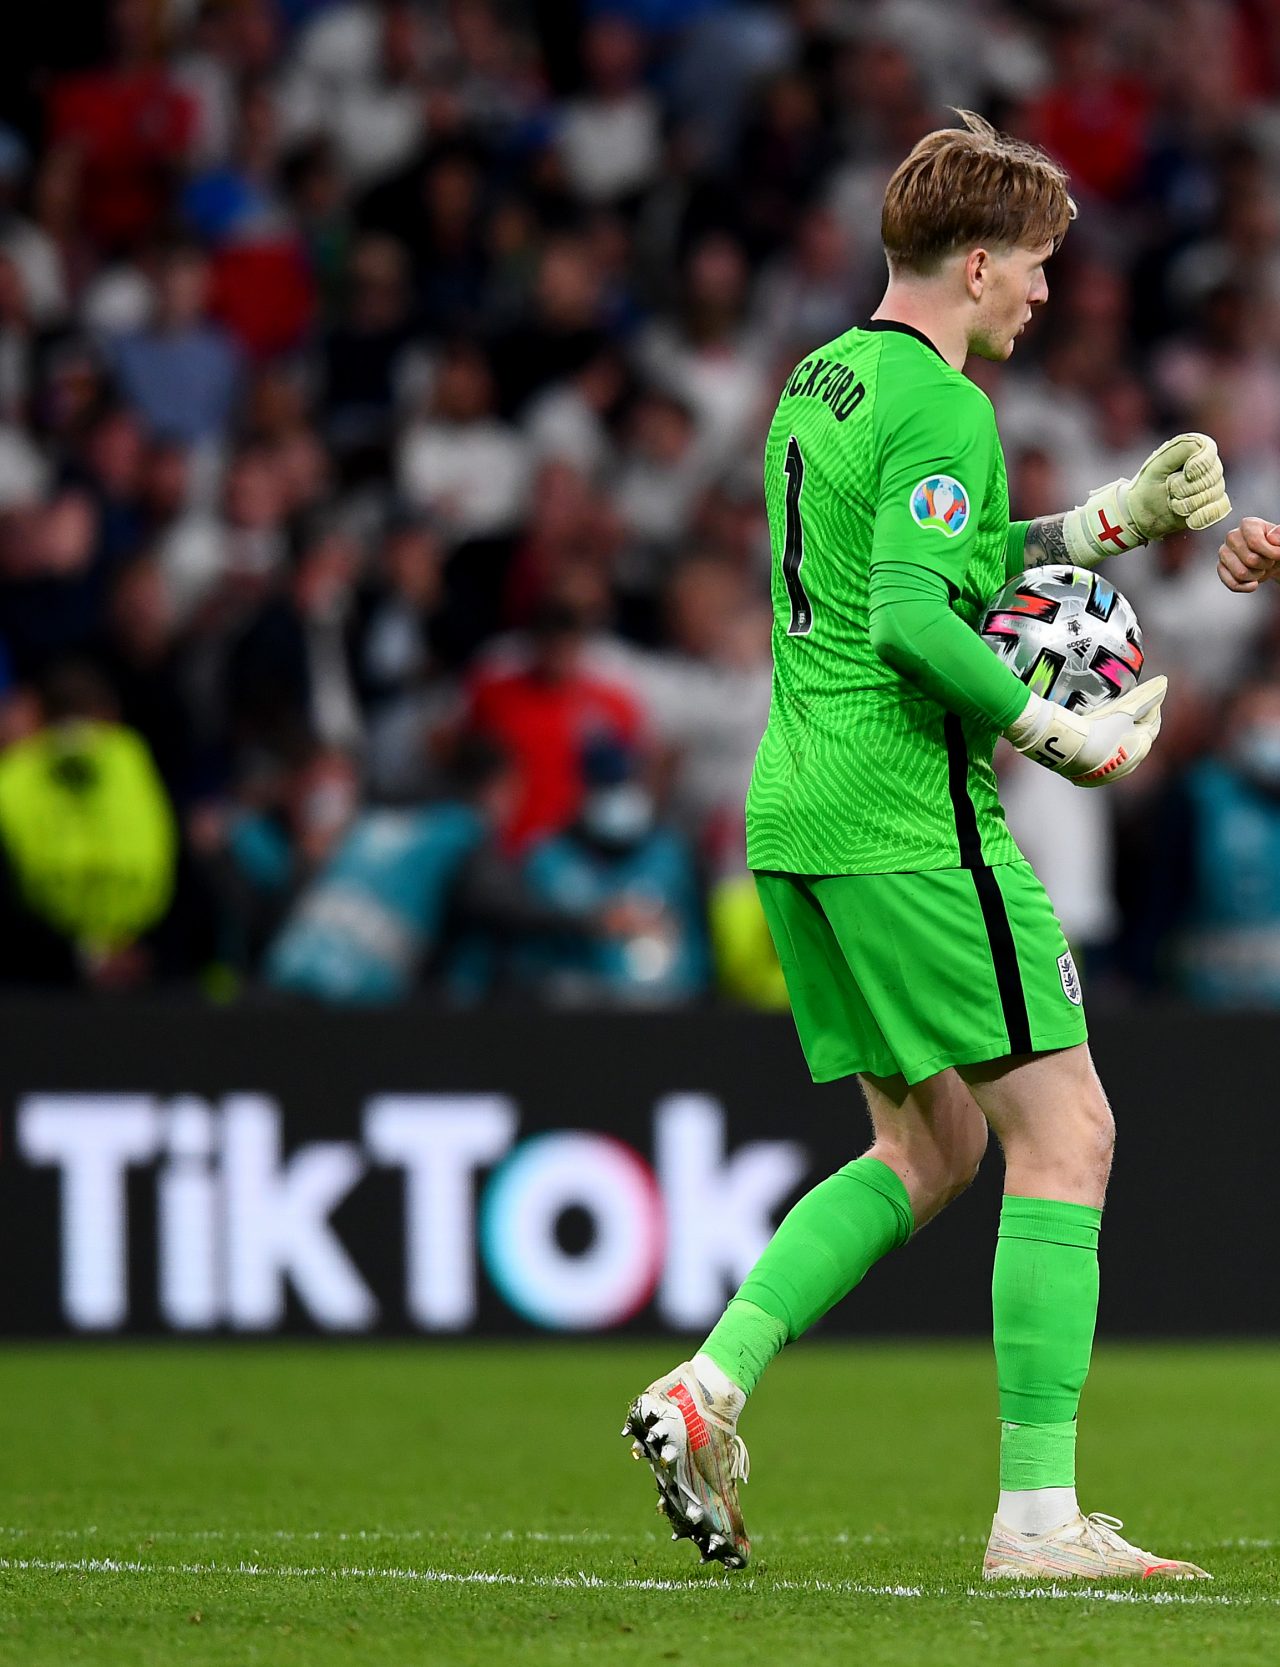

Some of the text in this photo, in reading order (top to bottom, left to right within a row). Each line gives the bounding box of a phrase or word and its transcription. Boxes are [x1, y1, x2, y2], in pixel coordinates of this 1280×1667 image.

[783, 436, 814, 635] 1
[1066, 636, 1092, 649] adidas
[16, 1093, 808, 1331] TikTok
